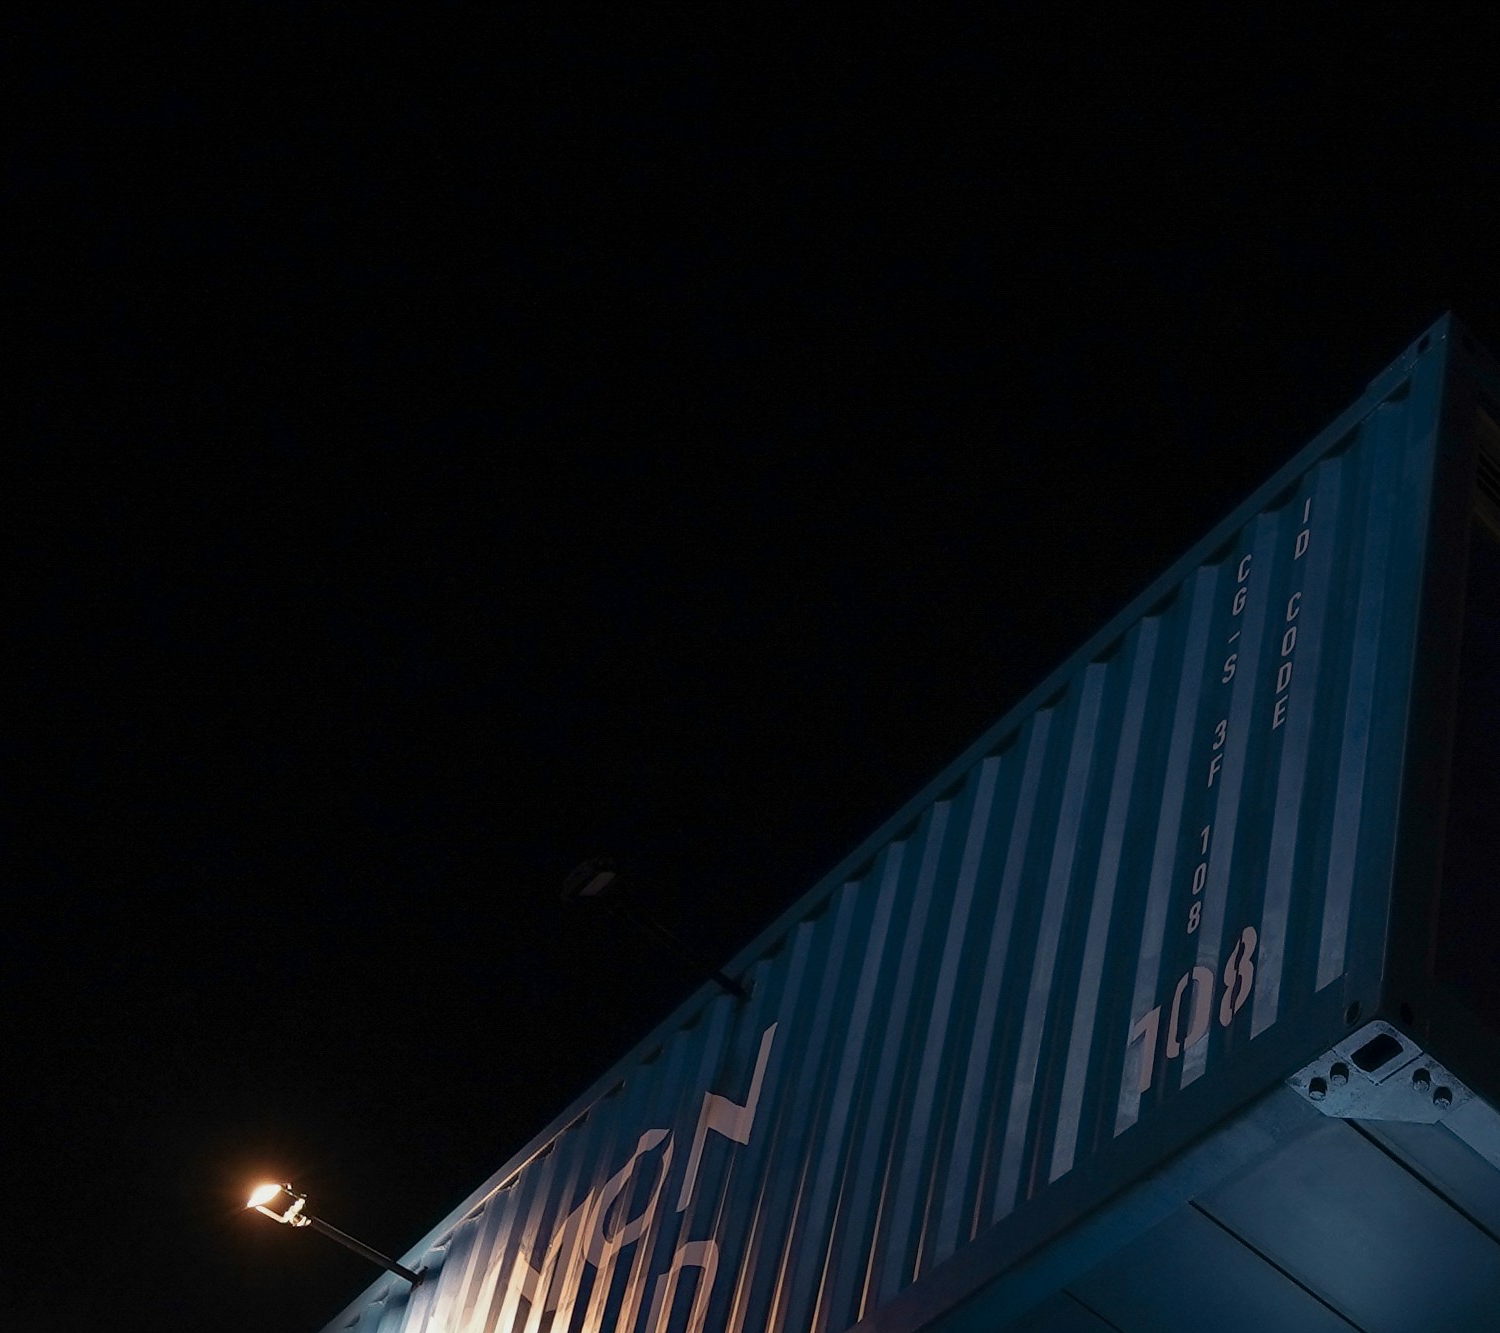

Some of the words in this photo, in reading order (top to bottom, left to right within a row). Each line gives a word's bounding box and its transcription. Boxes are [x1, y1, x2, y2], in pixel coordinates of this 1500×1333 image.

[1294, 498, 1311, 561] ID
[1272, 592, 1302, 730] CODE
[1207, 723, 1227, 788] 3F
[1186, 826, 1209, 934] 108
[1123, 925, 1256, 1095] 108
